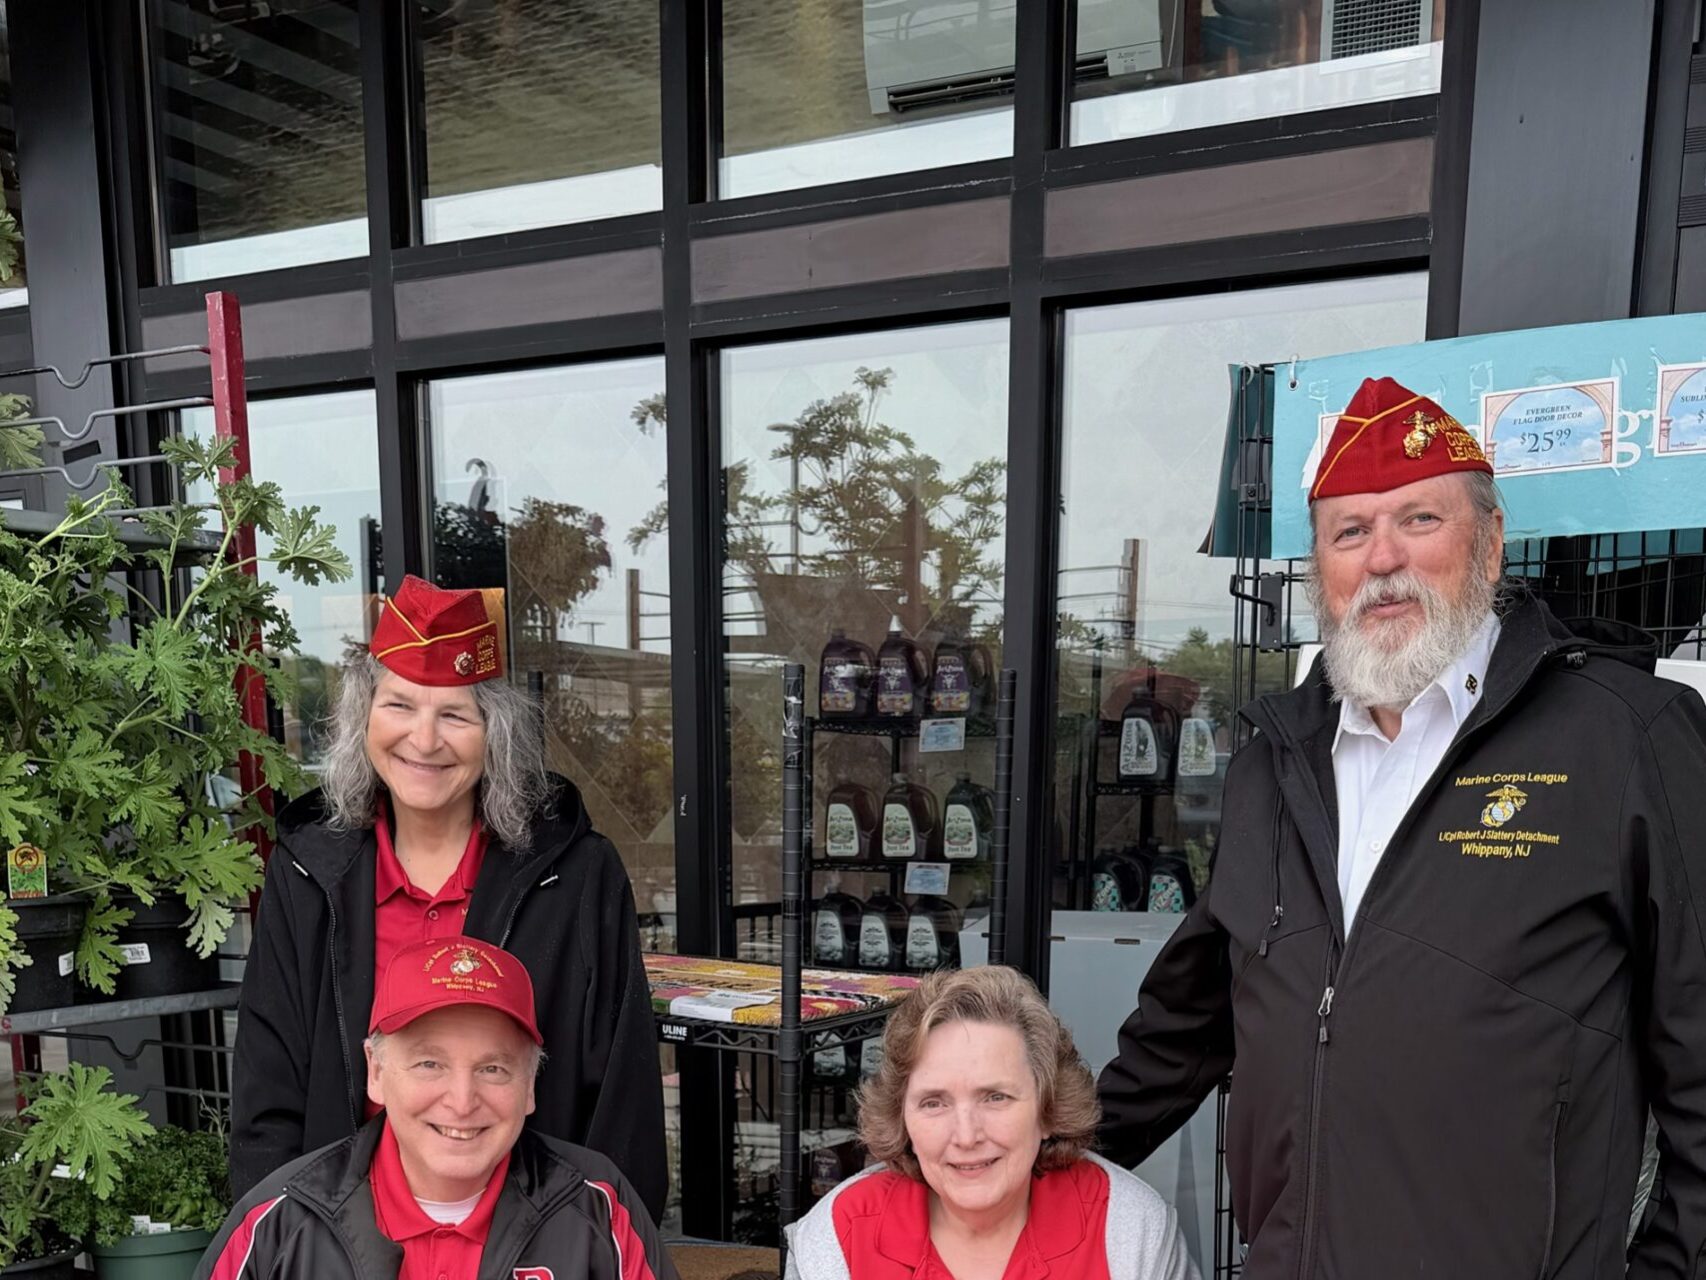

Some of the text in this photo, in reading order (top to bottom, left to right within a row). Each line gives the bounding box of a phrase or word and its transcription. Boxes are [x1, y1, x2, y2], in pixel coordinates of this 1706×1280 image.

[1681, 394, 1706, 403] SUBLI
[1526, 405, 1571, 416] EVERGREEN
[1513, 411, 1583, 425] FLAG DOOR DECOR
[1455, 773, 1568, 787] Marine Corps League
[1457, 830, 1480, 840] Robert
[1480, 830, 1487, 840] J
[1487, 830, 1516, 842] Slattery
[1516, 830, 1560, 845] Detachment
[1462, 842, 1531, 858] Whippany, NJ
[662, 1023, 688, 1037] ULINE
